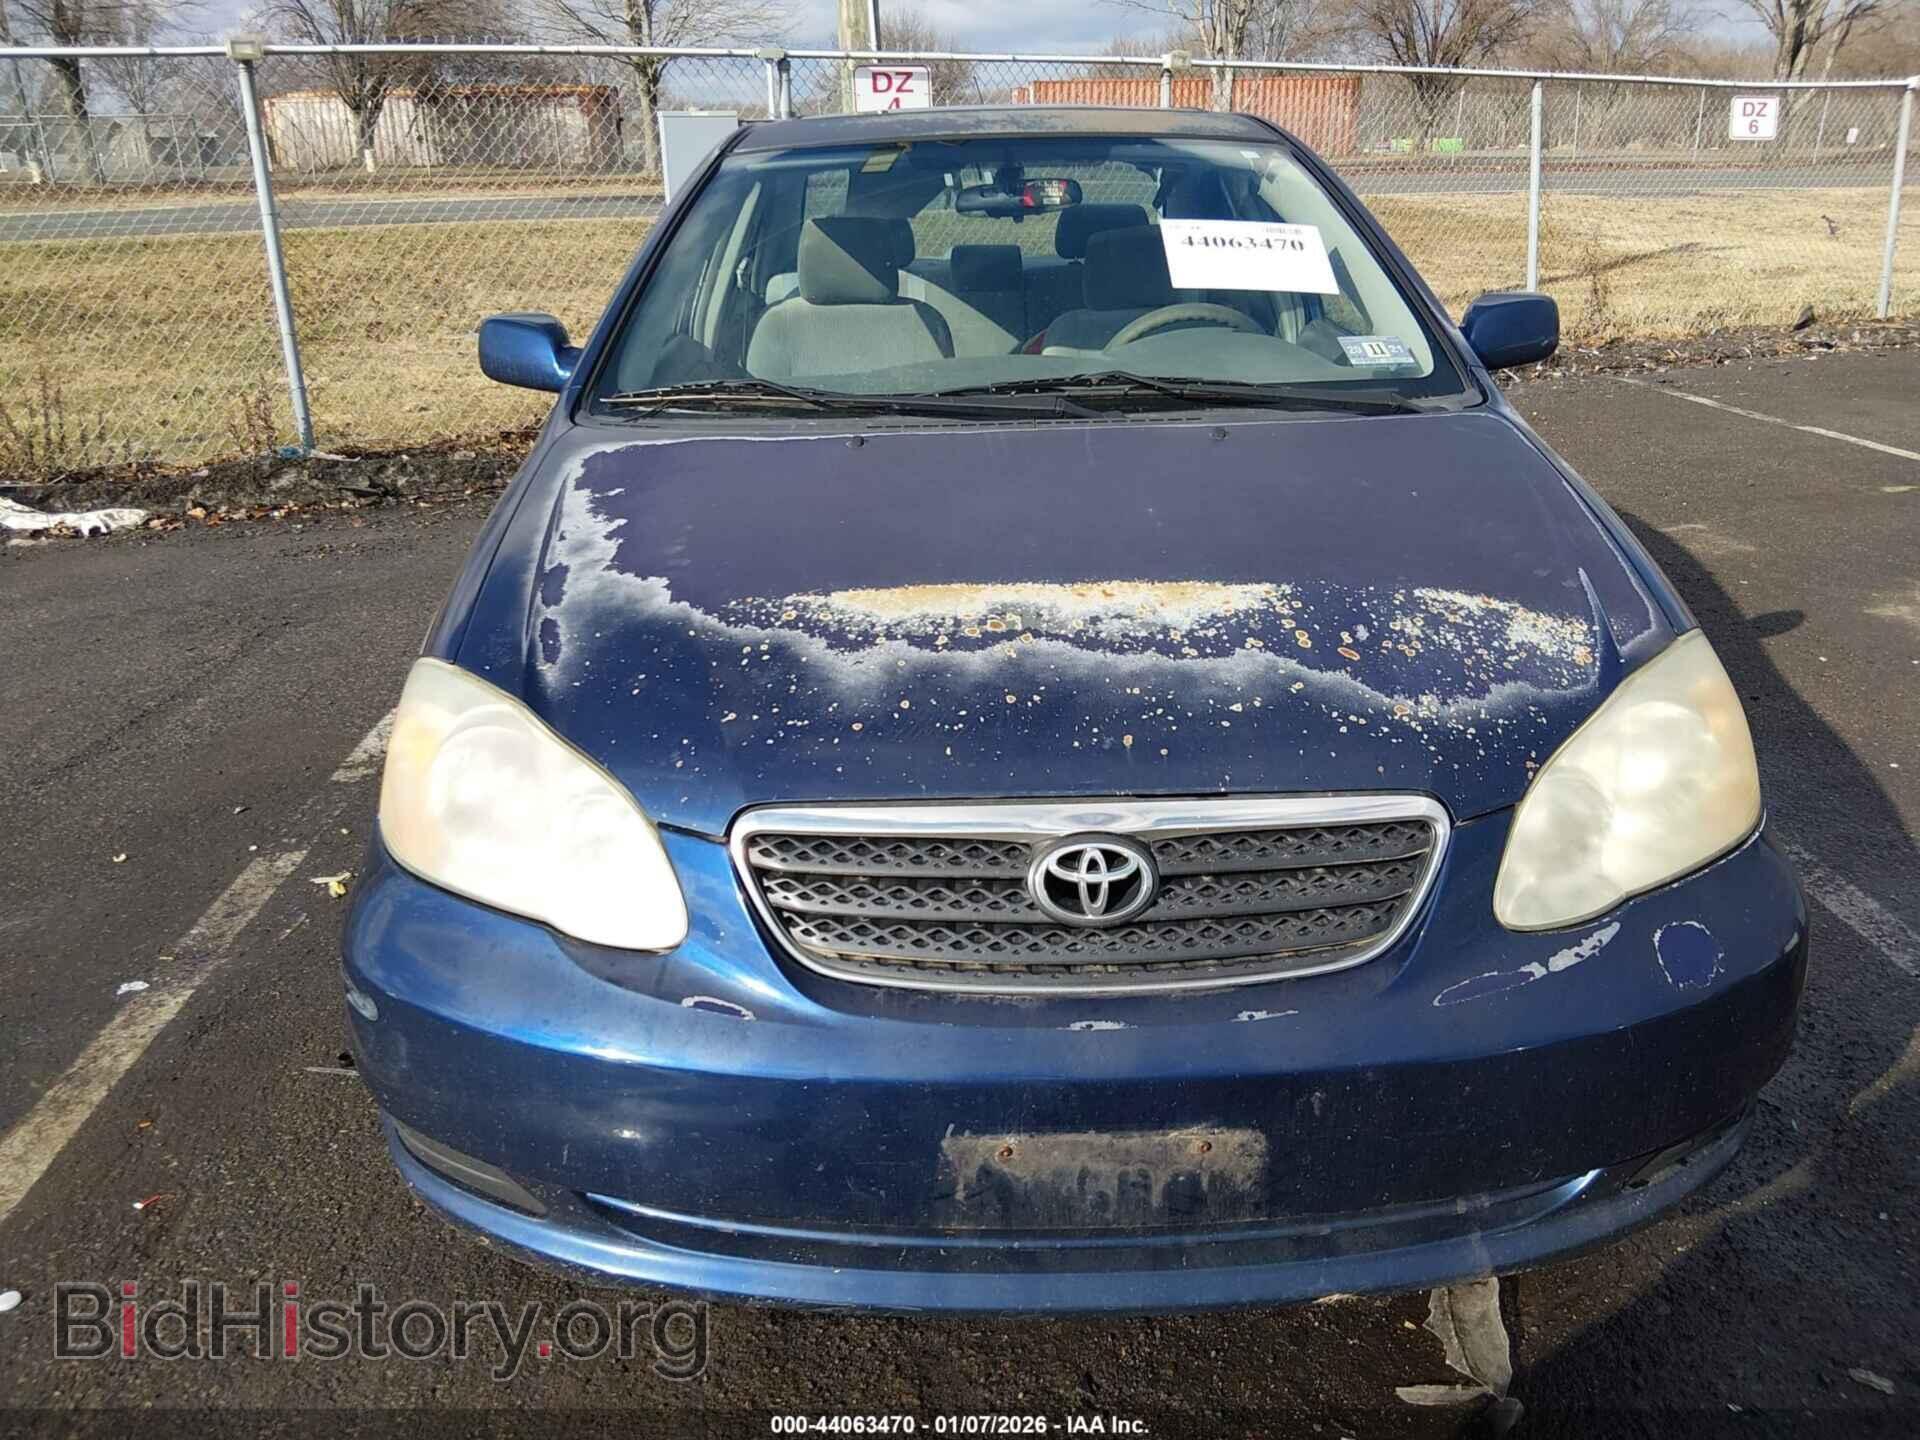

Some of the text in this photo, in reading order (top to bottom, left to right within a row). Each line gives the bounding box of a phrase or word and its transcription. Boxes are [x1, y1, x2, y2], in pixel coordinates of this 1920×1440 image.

[872, 72, 913, 92] DZ
[1743, 102, 1768, 117] DZ
[1748, 119, 1759, 134] 6
[1181, 235, 1304, 251] 44063470
